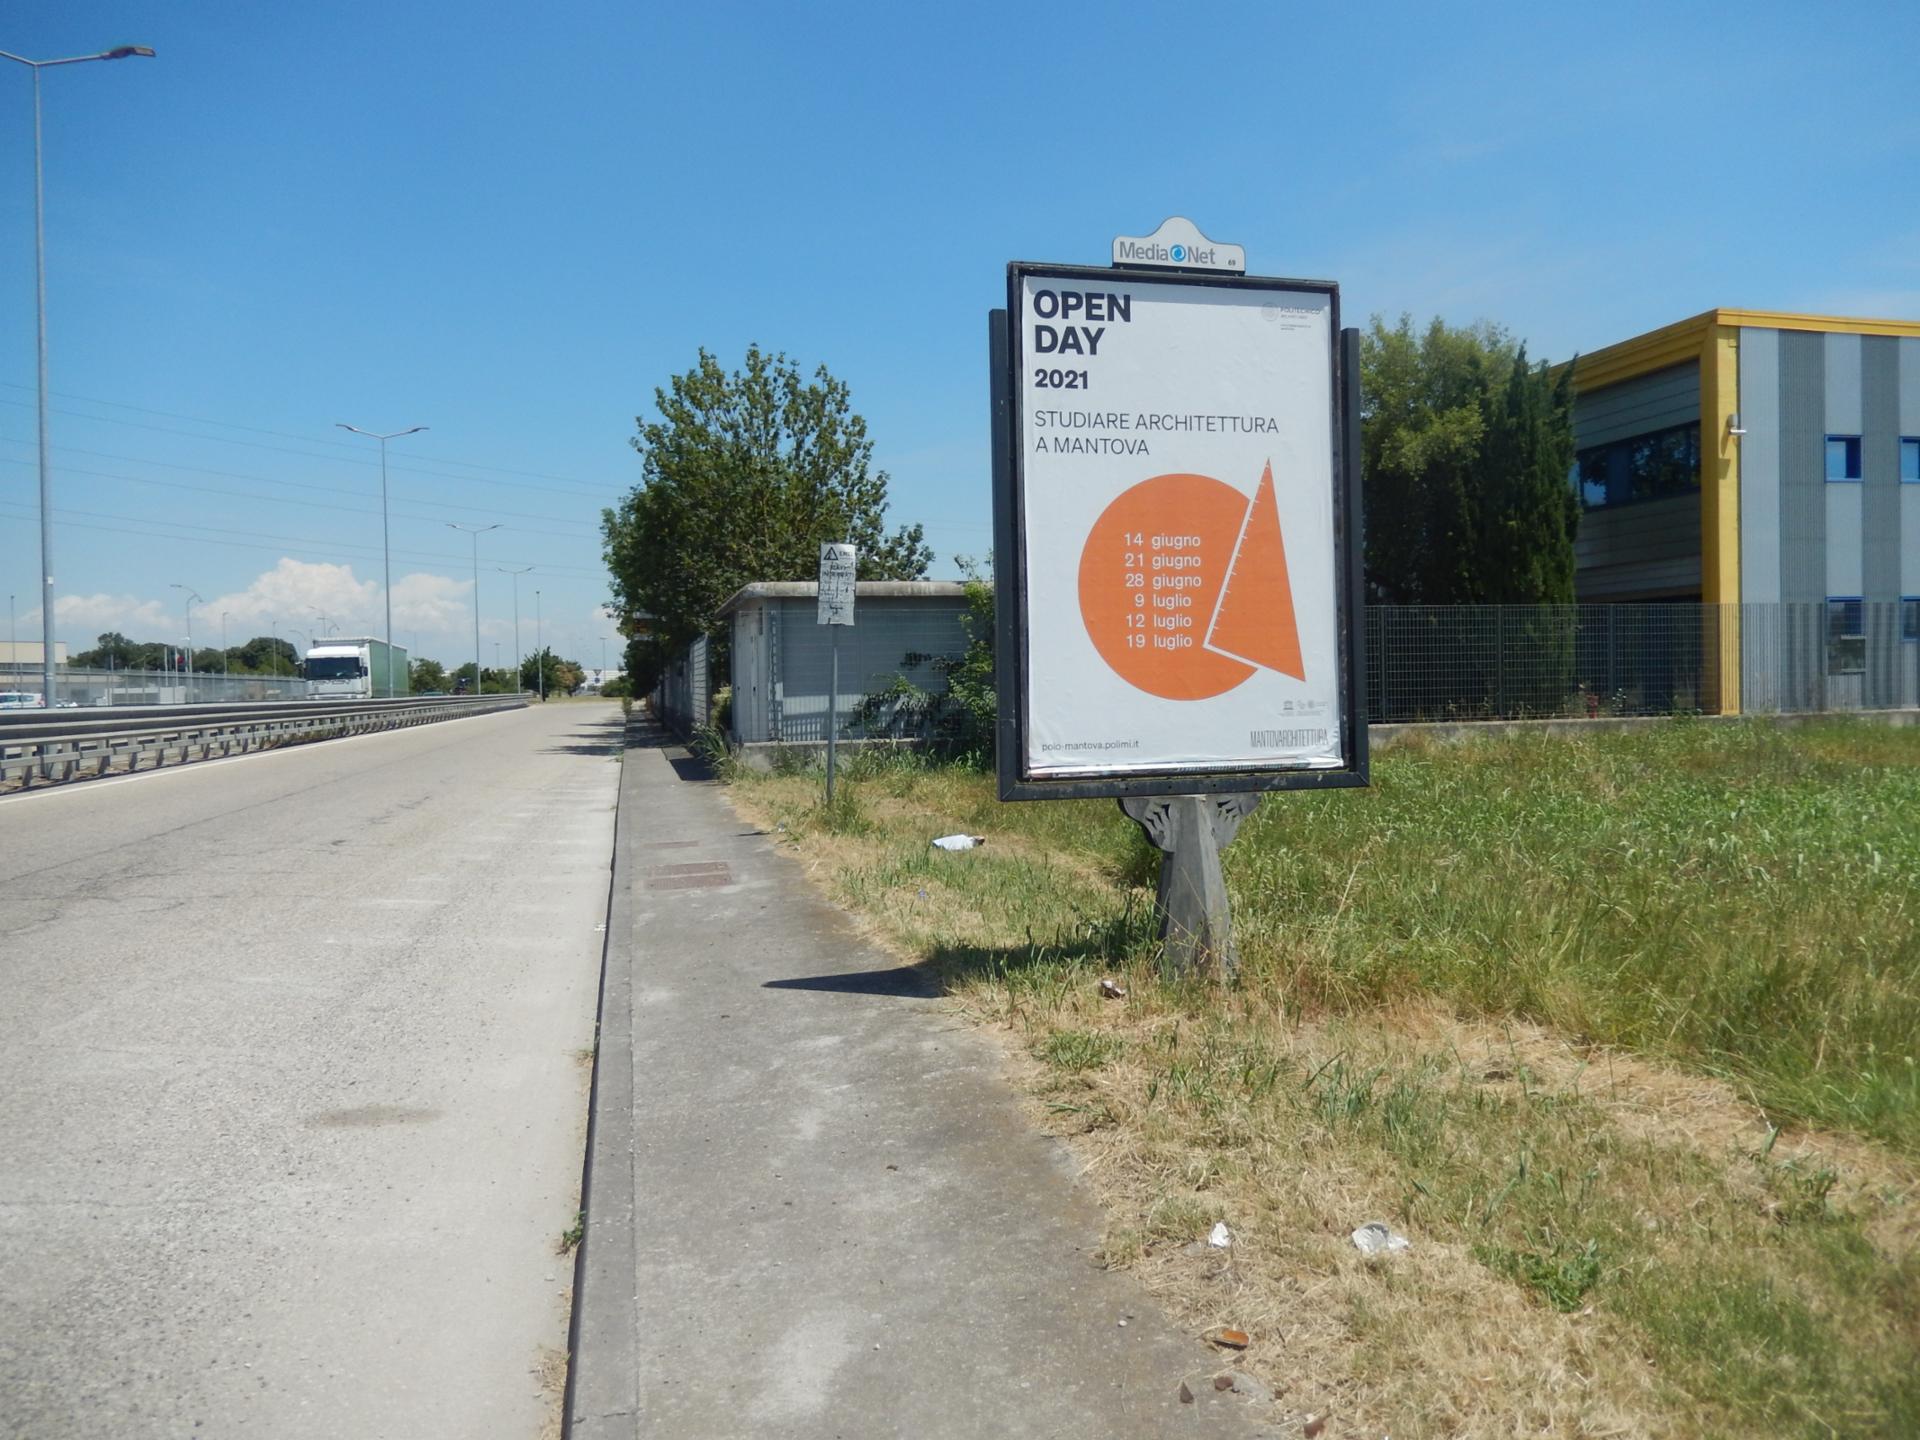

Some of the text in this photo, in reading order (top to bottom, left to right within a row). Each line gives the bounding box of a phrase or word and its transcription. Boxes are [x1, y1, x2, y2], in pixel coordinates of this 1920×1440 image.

[1033, 289, 1131, 323] OPEN
[1034, 325, 1106, 355] DAY
[1034, 368, 1088, 390] 2021
[1034, 410, 1279, 433] STUDIARE ARCHITETTURA
[1036, 436, 1150, 455] A MANTOVA
[1124, 533, 1201, 550] 14 giugno
[1125, 553, 1201, 570] 21 giugno
[1125, 573, 1202, 590] 28 giugno
[1134, 593, 1192, 610] 9 luglio
[1126, 613, 1192, 630] 12 luglio
[1126, 633, 1193, 650] 19 luglio
